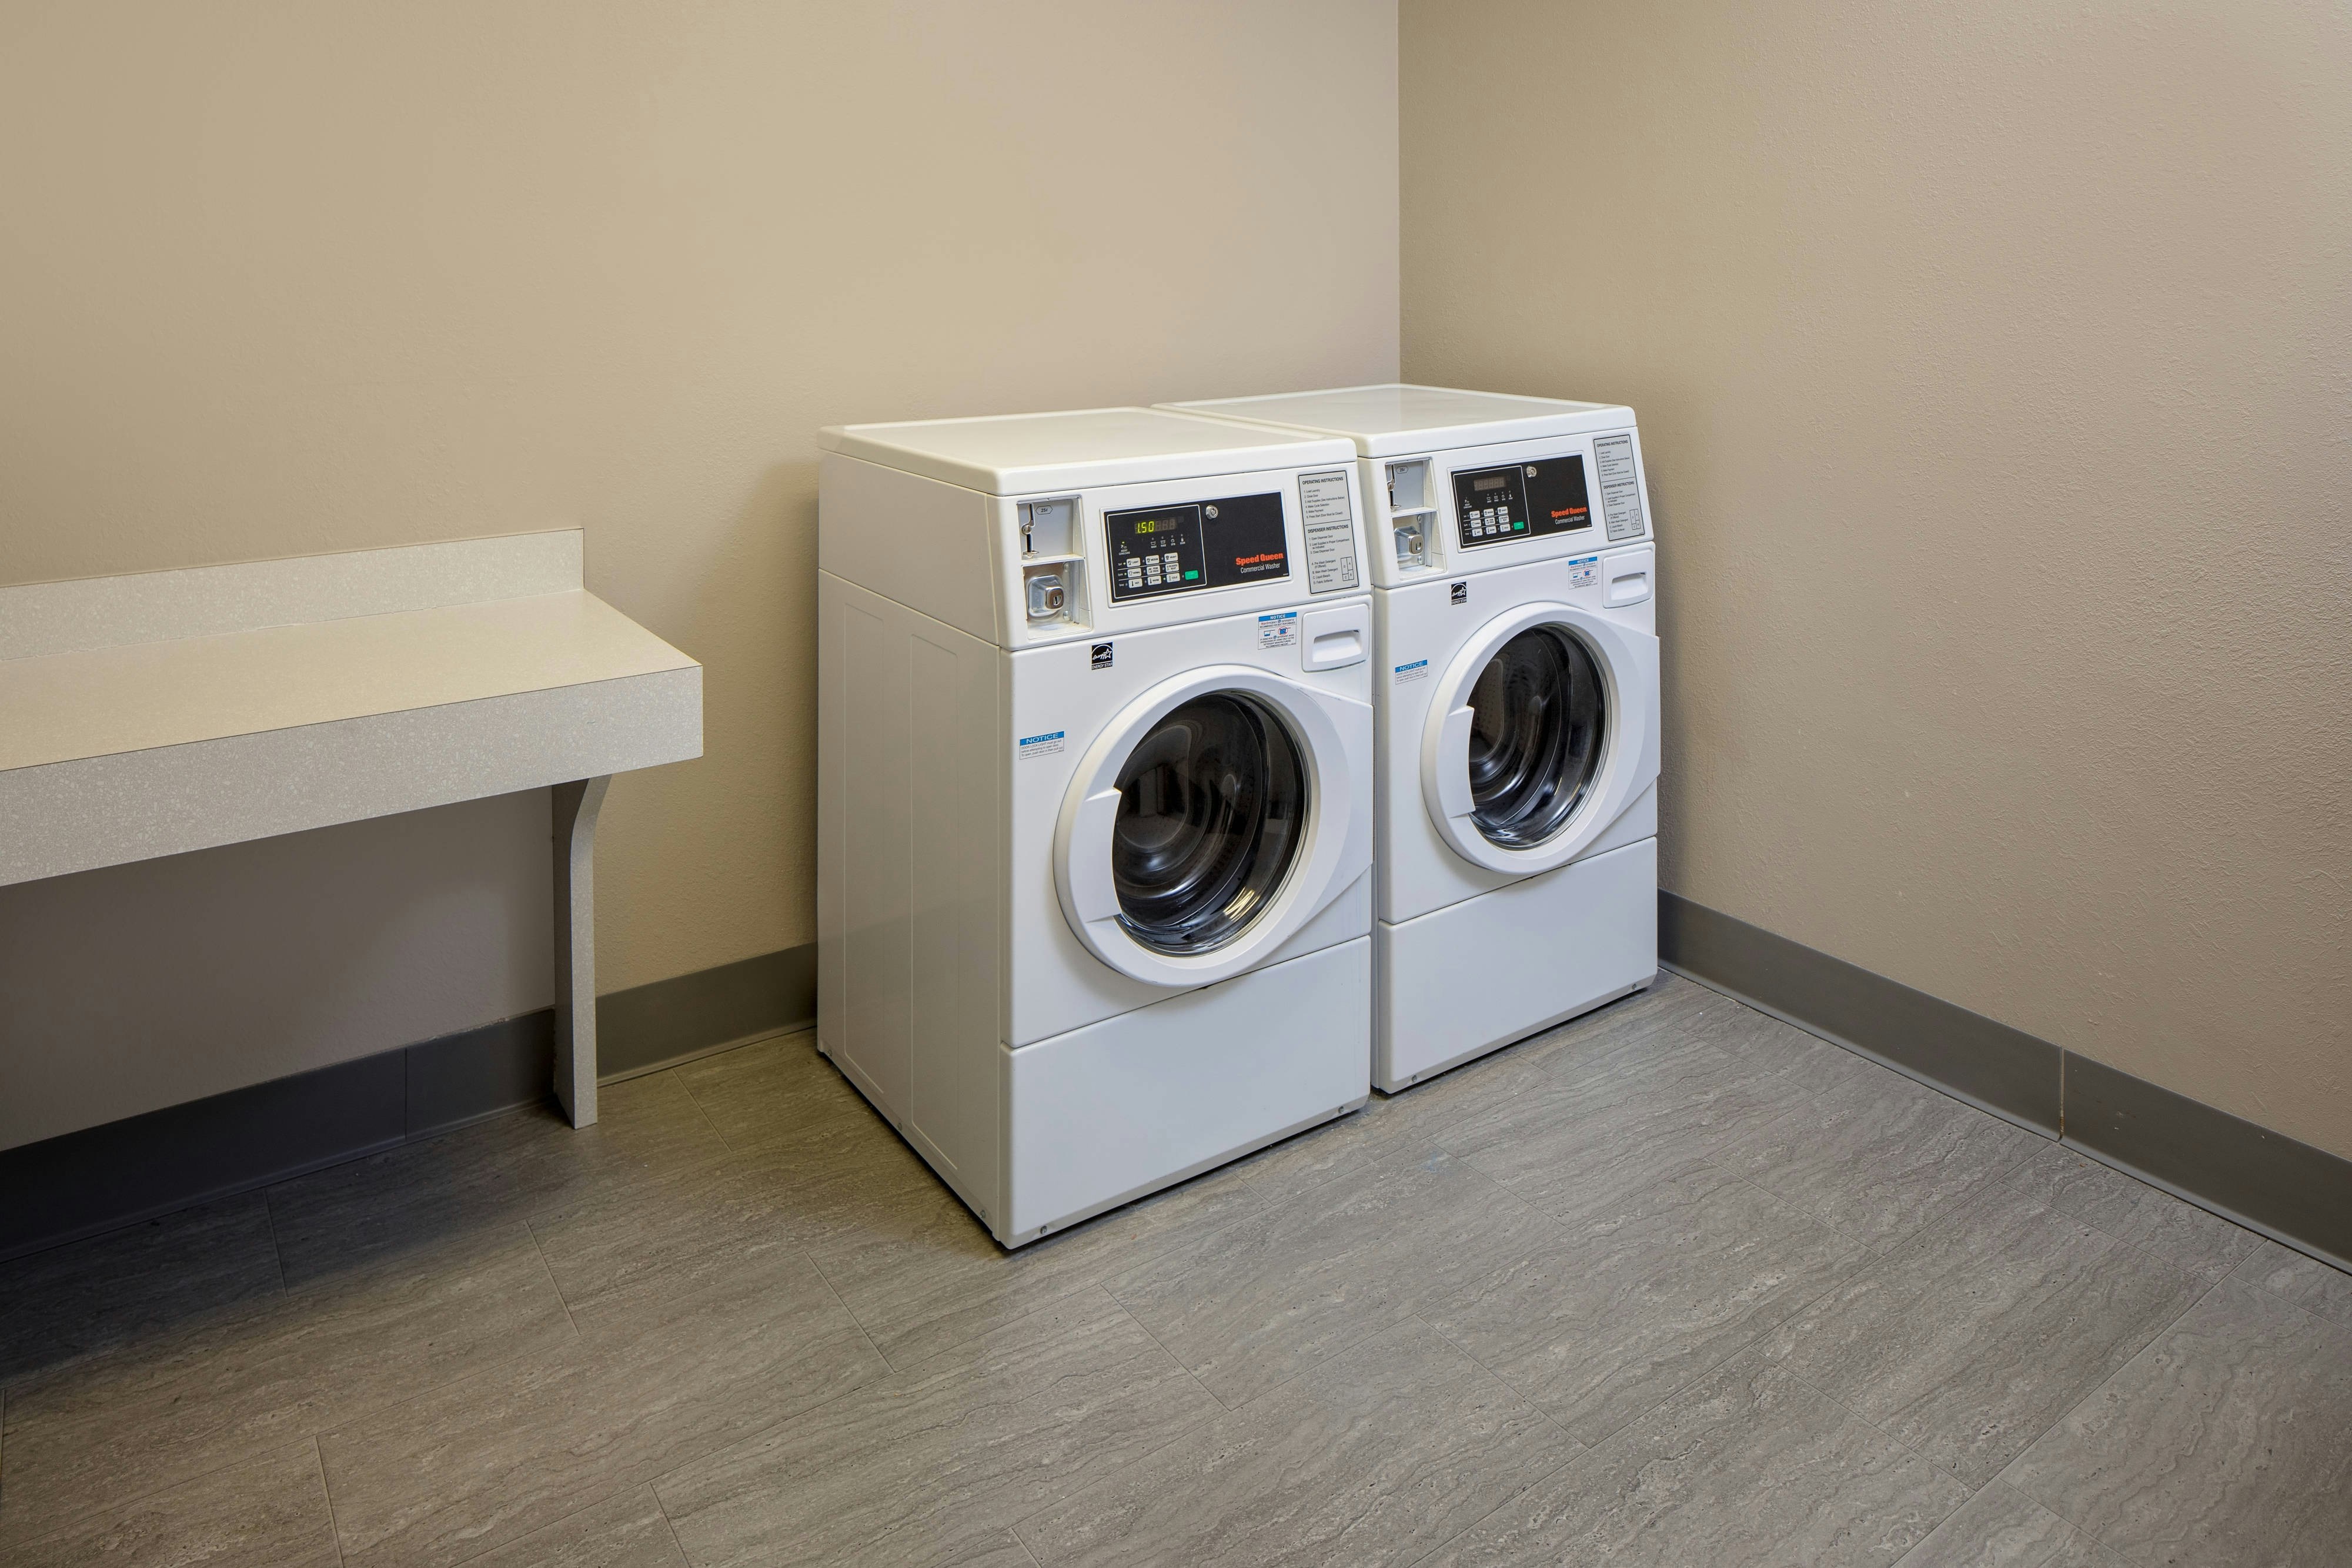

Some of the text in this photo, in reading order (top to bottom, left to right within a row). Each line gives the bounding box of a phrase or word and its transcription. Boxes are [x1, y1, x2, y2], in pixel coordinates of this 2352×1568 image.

[1551, 509, 1569, 518] Speed
[1137, 520, 1154, 533] 1.50
[1236, 553, 1284, 566] Speed Queen
[1240, 564, 1265, 573] Commercial
[1399, 661, 1423, 671] NOTICE
[1026, 733, 1058, 744] NOTICE
